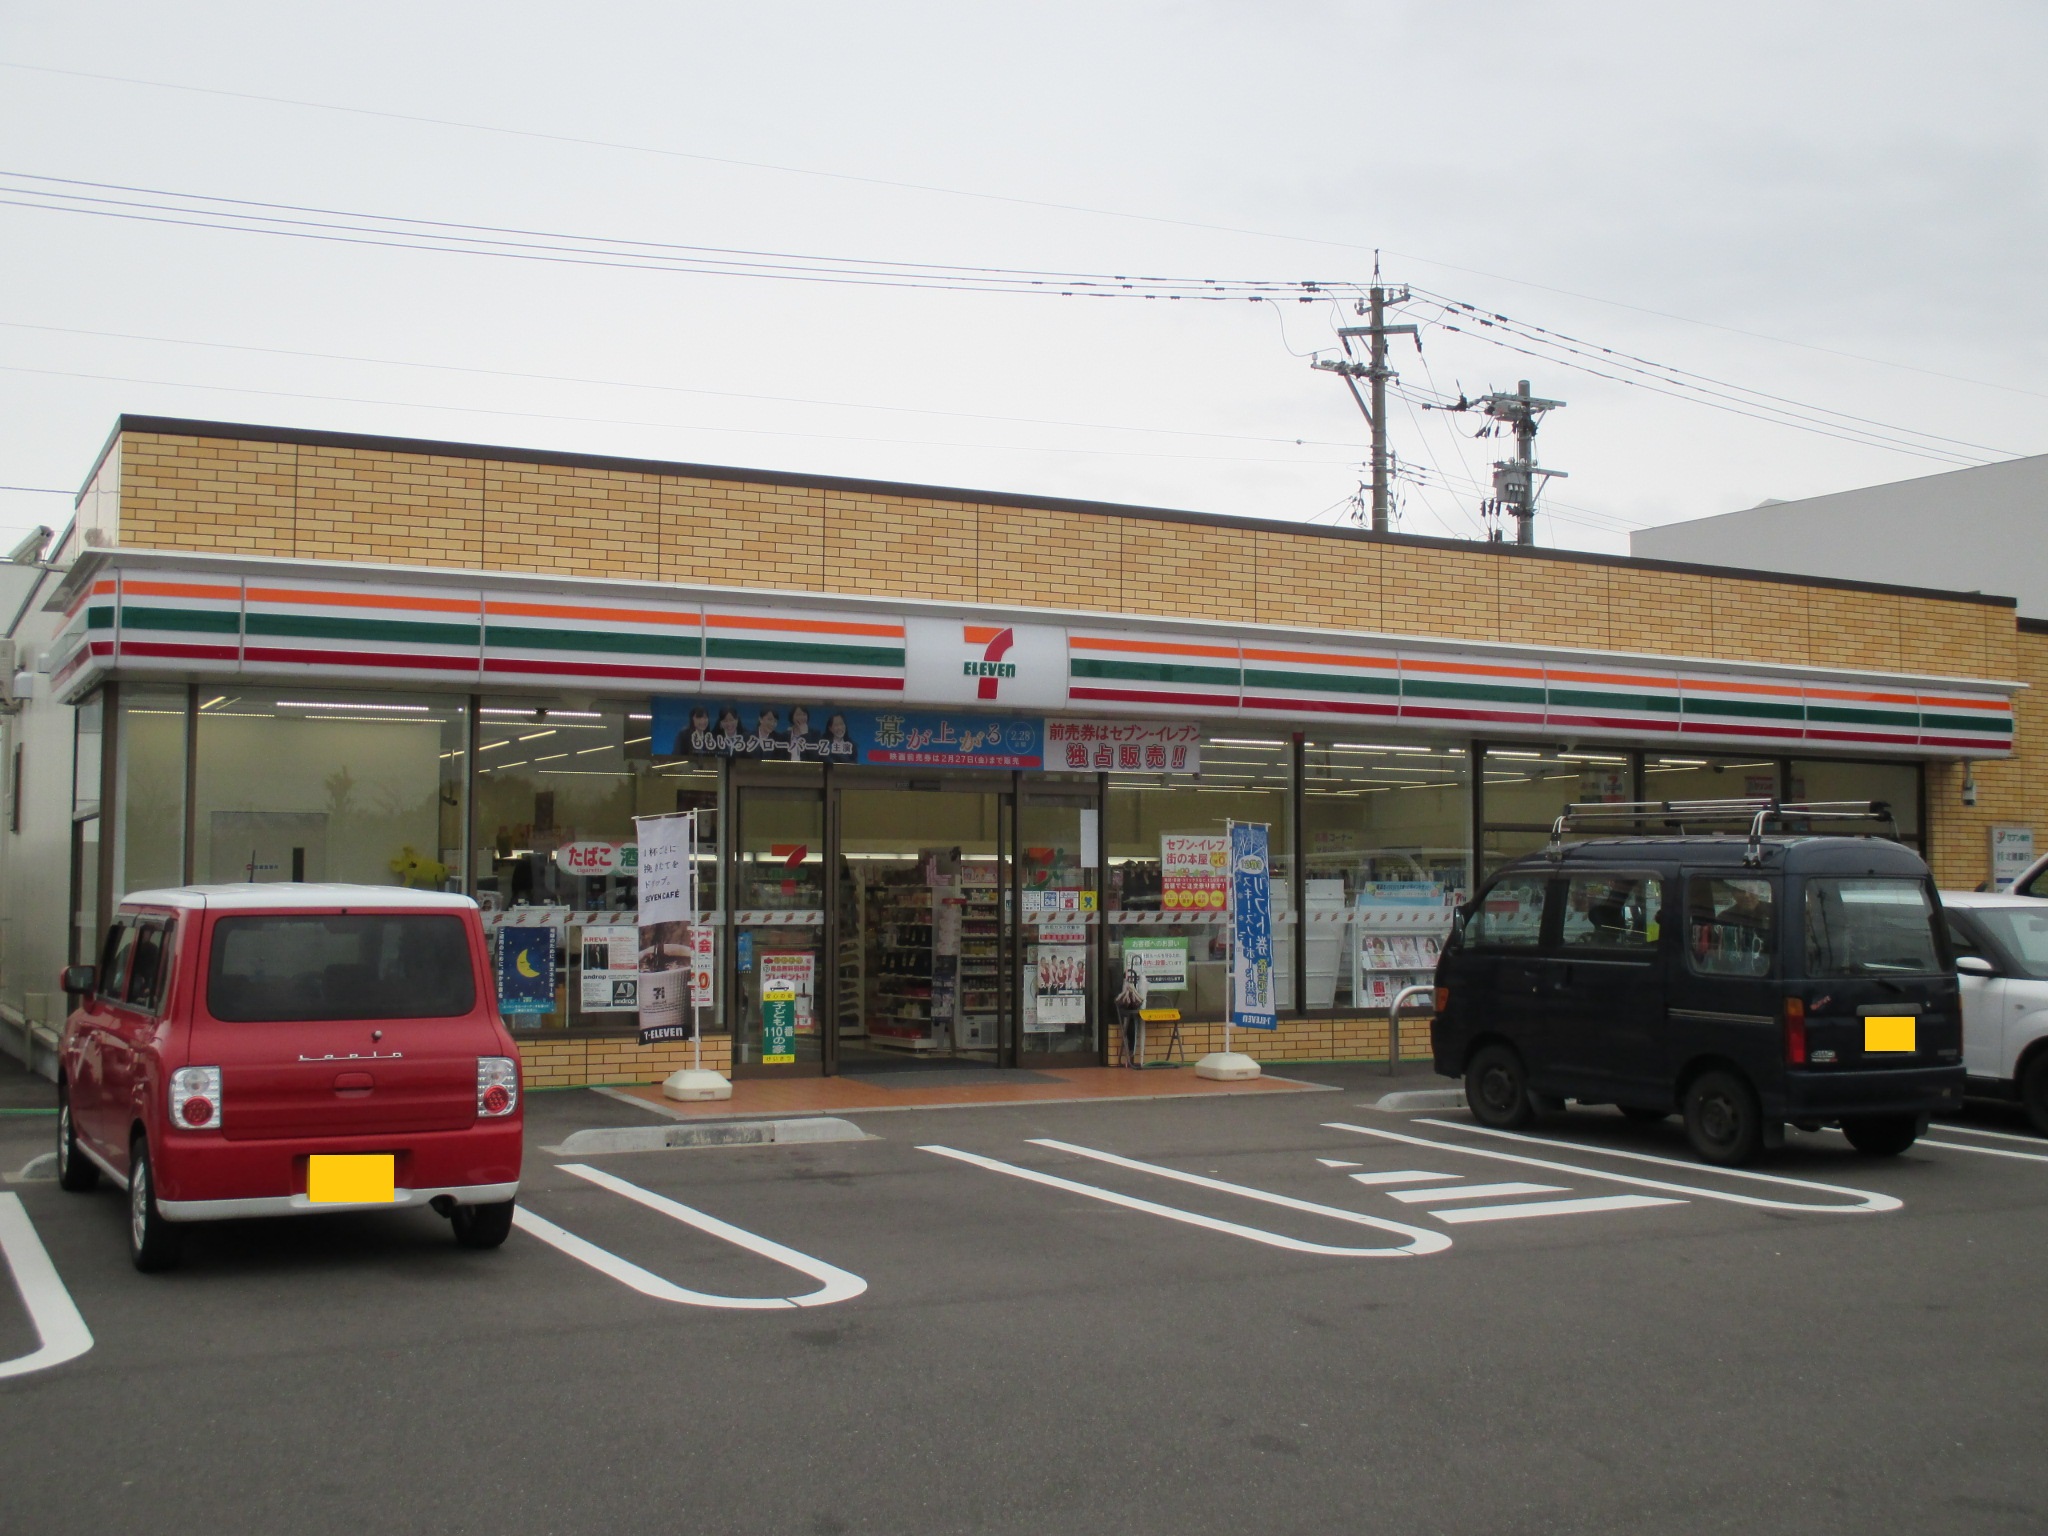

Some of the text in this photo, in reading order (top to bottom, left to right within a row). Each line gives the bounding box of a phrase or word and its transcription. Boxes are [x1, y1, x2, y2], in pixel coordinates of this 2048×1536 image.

[875, 714, 1002, 752] 幕が上がる
[1010, 730, 1031, 741] 2.28
[691, 730, 852, 756] ももいろクローバーZ 主演
[889, 752, 1020, 765] 映画前売券は2月27日(金)まで販売
[1166, 839, 1232, 850] セブン-イレブ
[568, 847, 638, 867] たばこ 酒
[1166, 853, 1208, 865] 街の本屋
[662, 889, 681, 901] CAFÉ
[1132, 940, 1180, 948] お客様へのお願い
